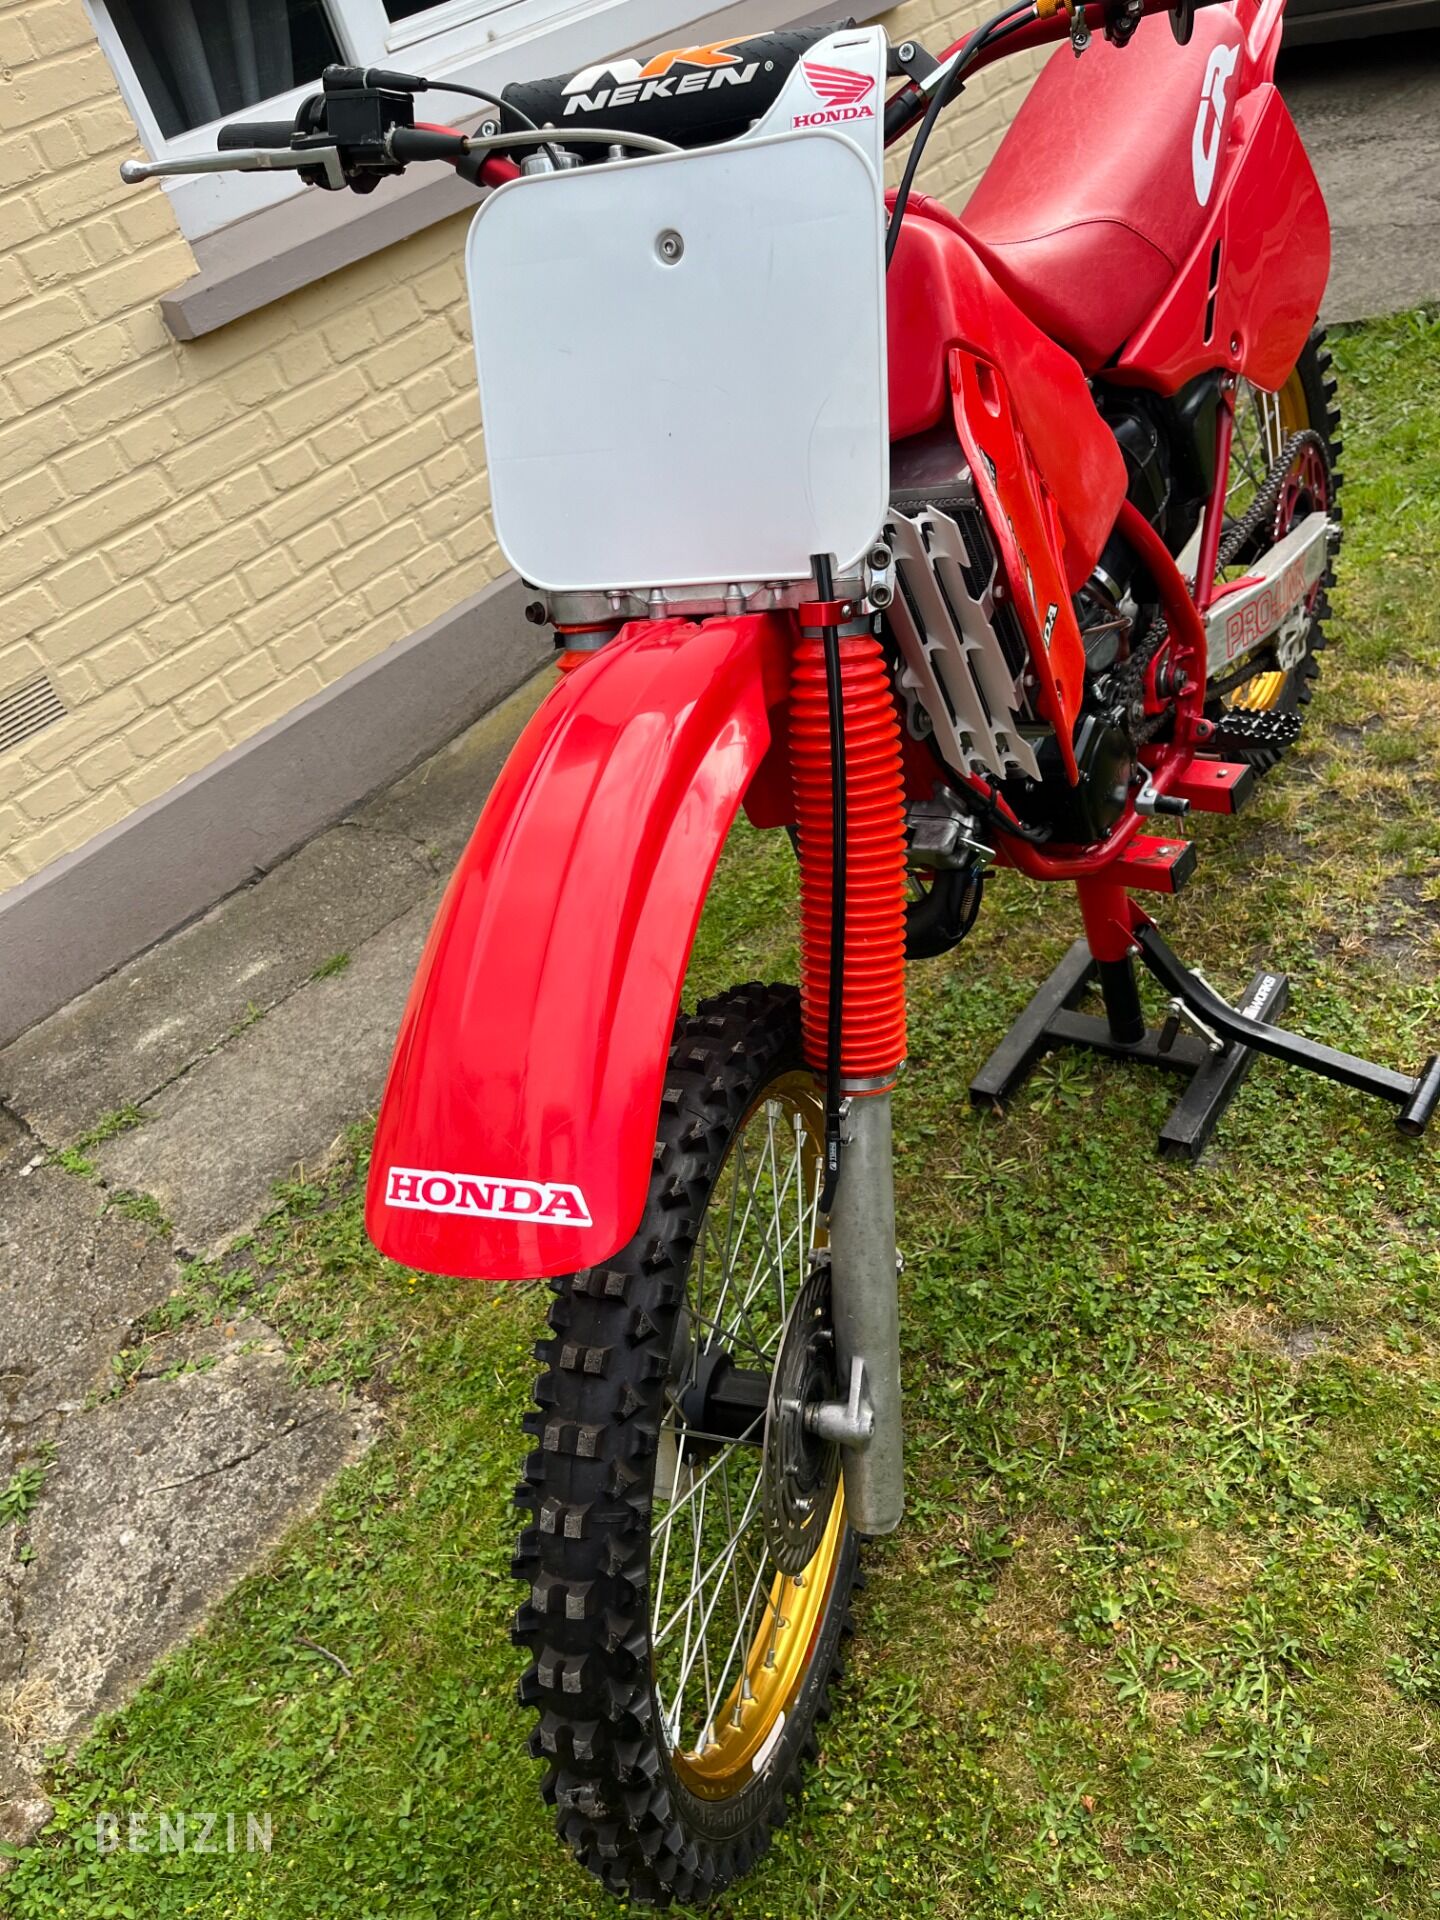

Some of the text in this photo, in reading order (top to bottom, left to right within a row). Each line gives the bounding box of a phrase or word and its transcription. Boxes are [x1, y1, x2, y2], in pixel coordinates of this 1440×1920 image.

[563, 63, 760, 116] NEKEN
[793, 105, 875, 129] HONDA
[1192, 43, 1240, 206] CR
[388, 1173, 589, 1220] HONDA
